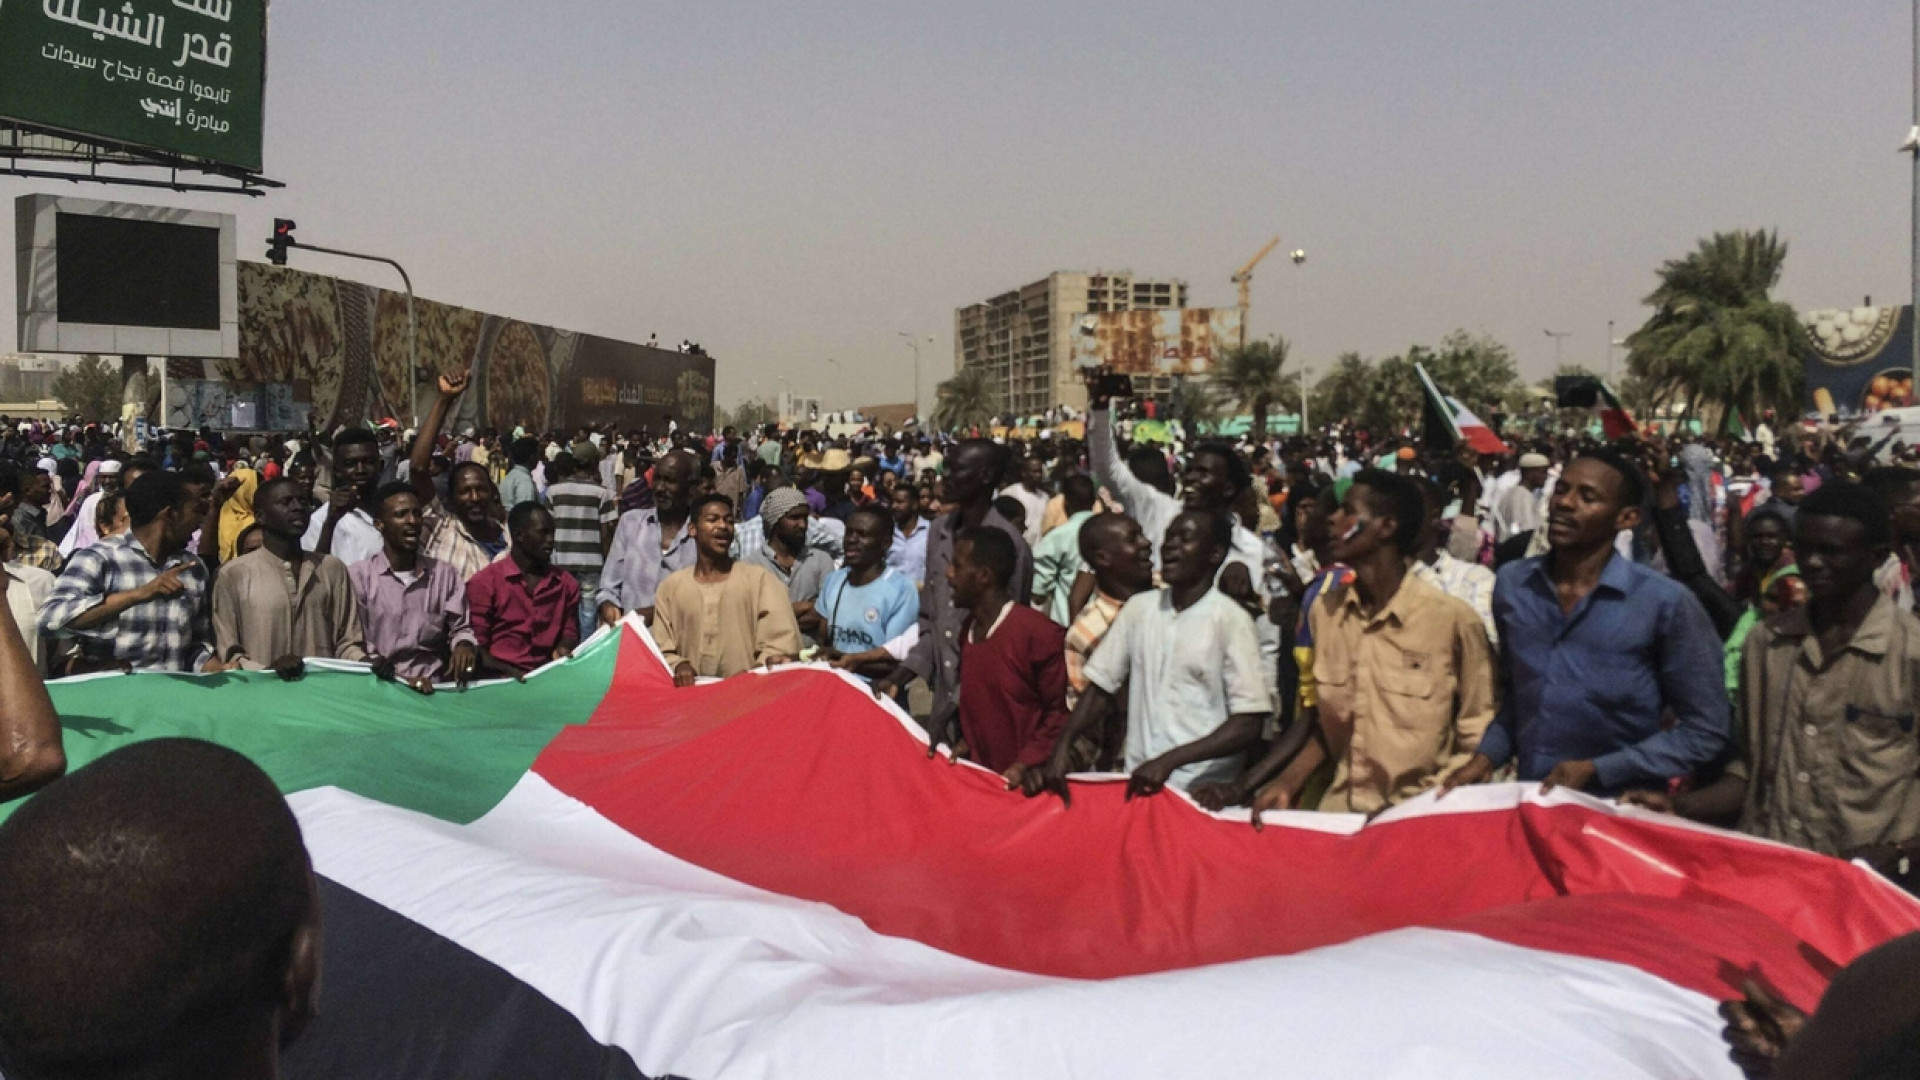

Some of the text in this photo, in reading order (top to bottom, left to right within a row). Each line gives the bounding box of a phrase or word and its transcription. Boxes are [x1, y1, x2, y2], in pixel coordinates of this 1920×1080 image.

[173, 32, 232, 68] قدر
[41, 42, 231, 104] تابعوا قصة نجاح سيدات
[186, 108, 229, 134] مبادرة
